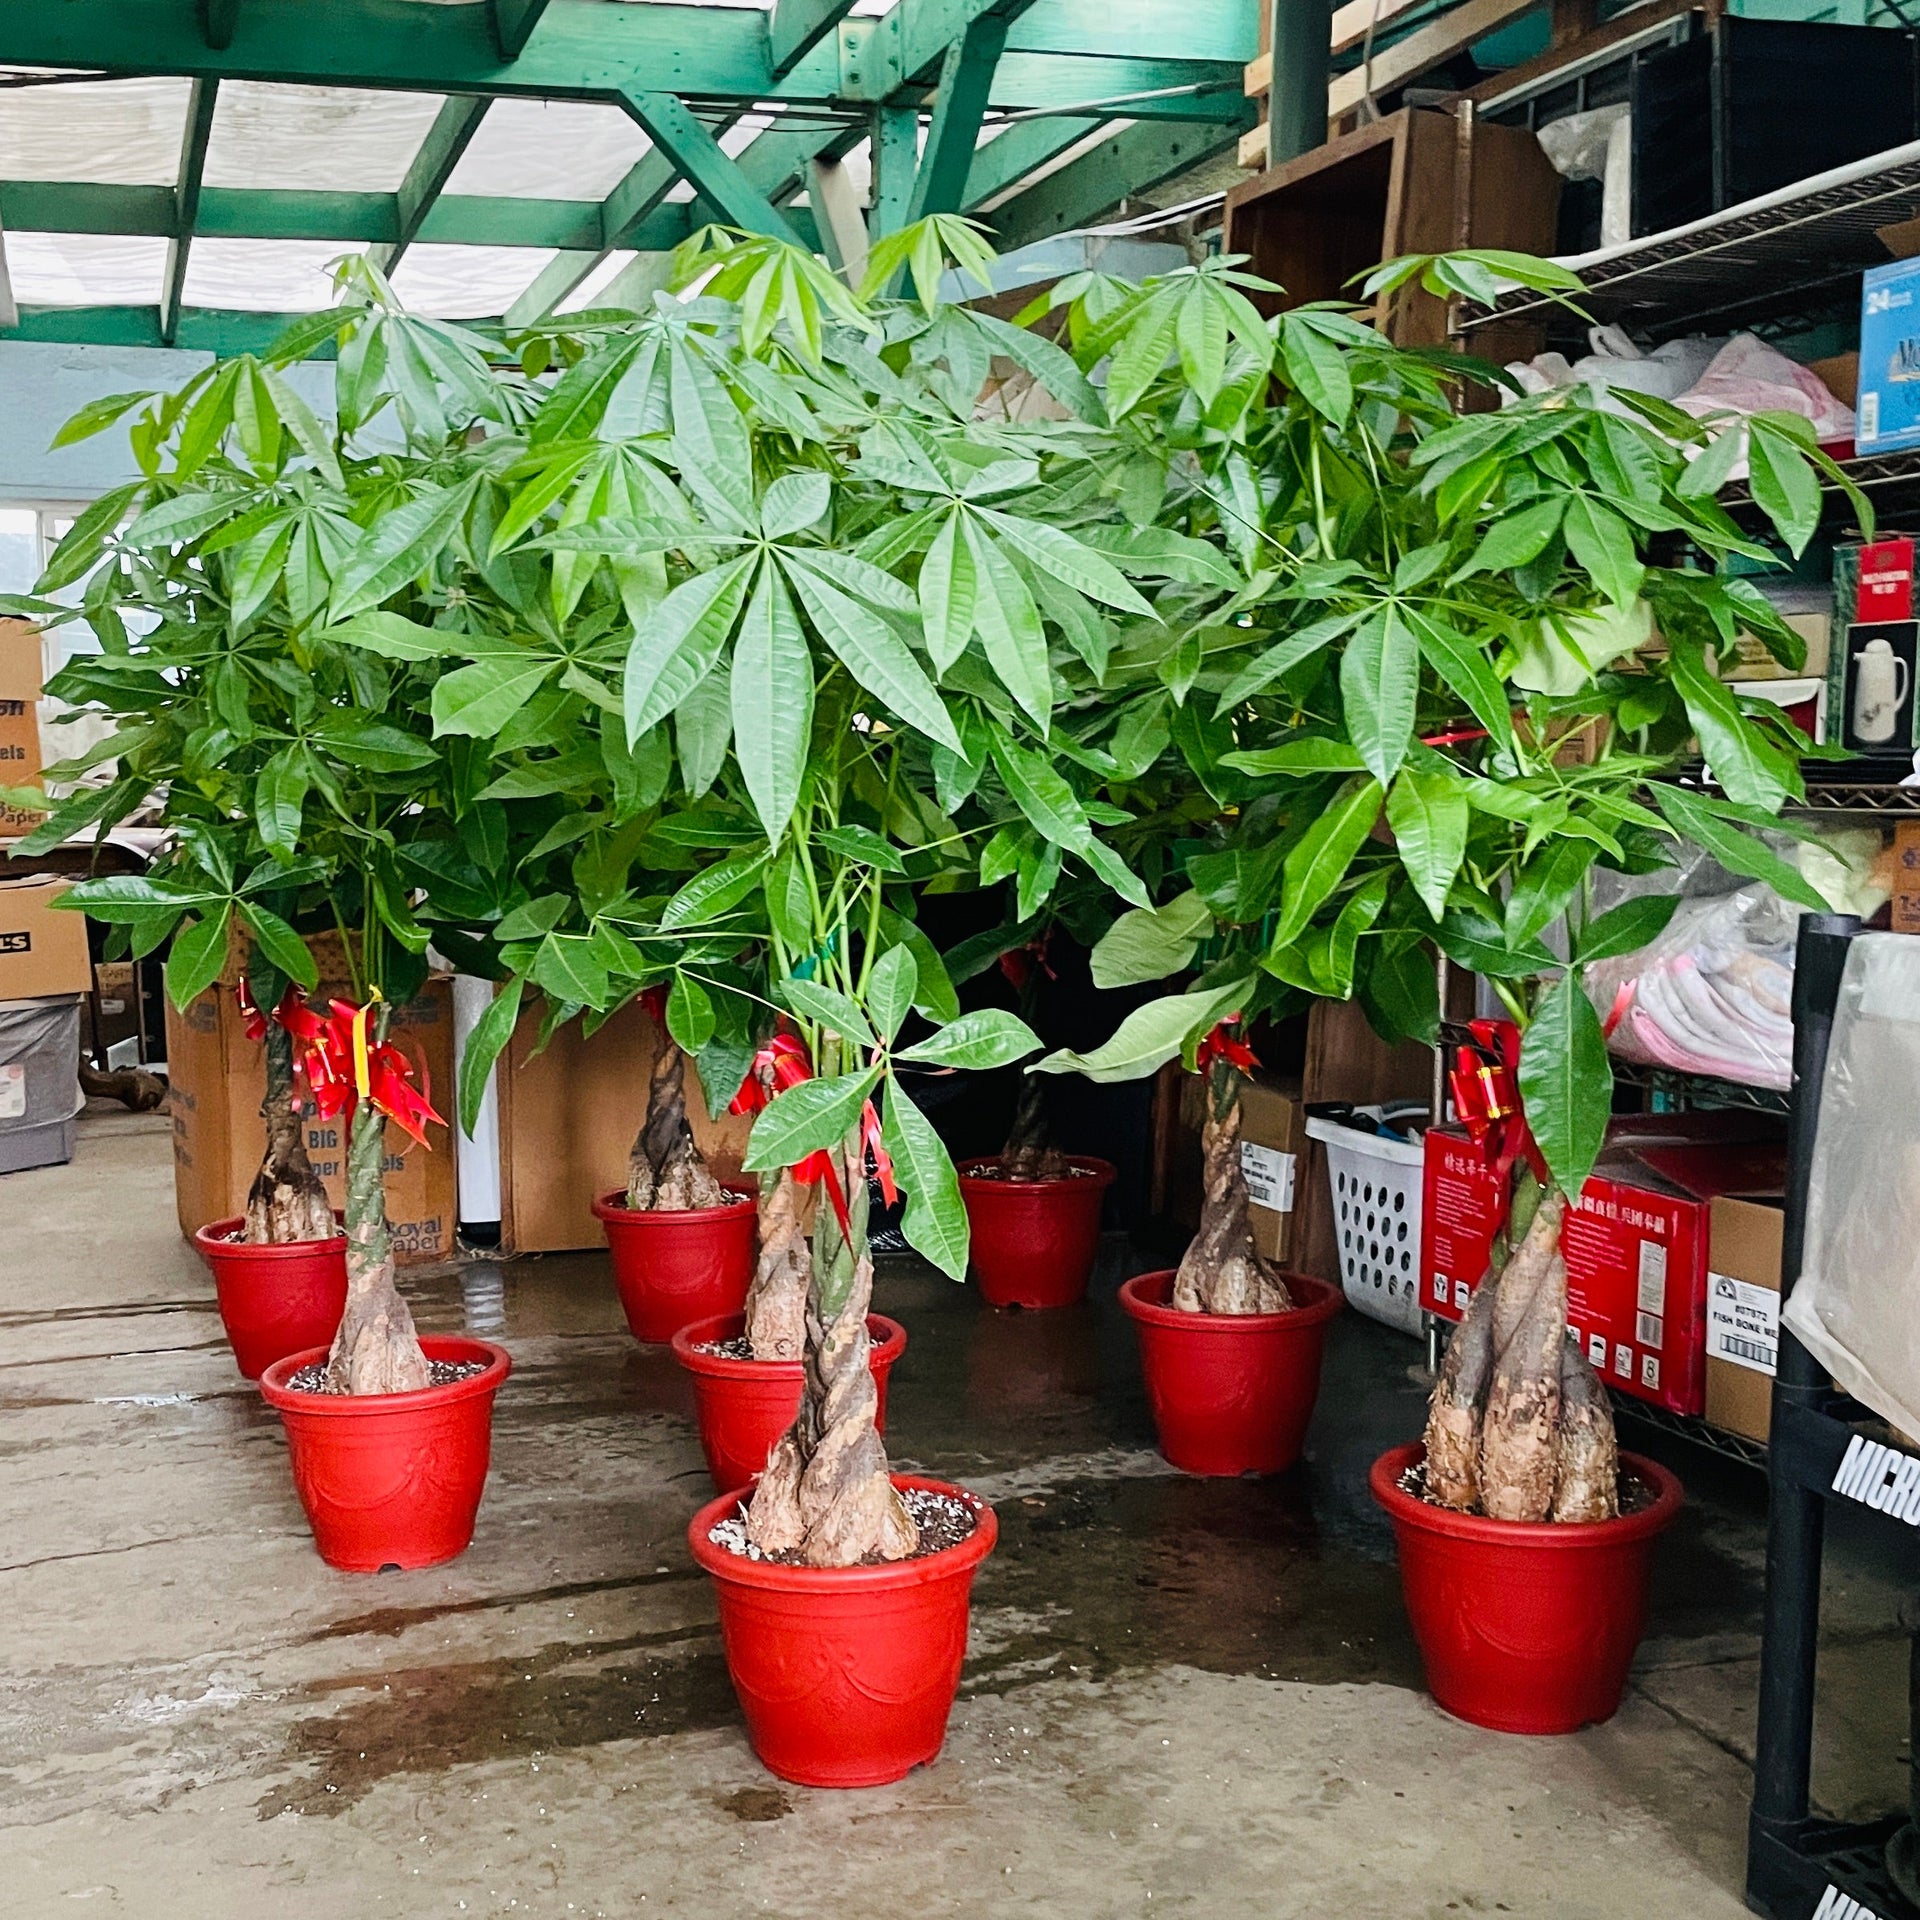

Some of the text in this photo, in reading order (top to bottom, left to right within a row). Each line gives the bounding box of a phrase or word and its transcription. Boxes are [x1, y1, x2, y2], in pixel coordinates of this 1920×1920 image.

[309, 1130, 337, 1149] BIG
[311, 1154, 405, 1177] per els
[390, 1234, 442, 1254] aper
[1713, 1311, 1734, 1326] FISH
[1736, 1318, 1761, 1334] BONE
